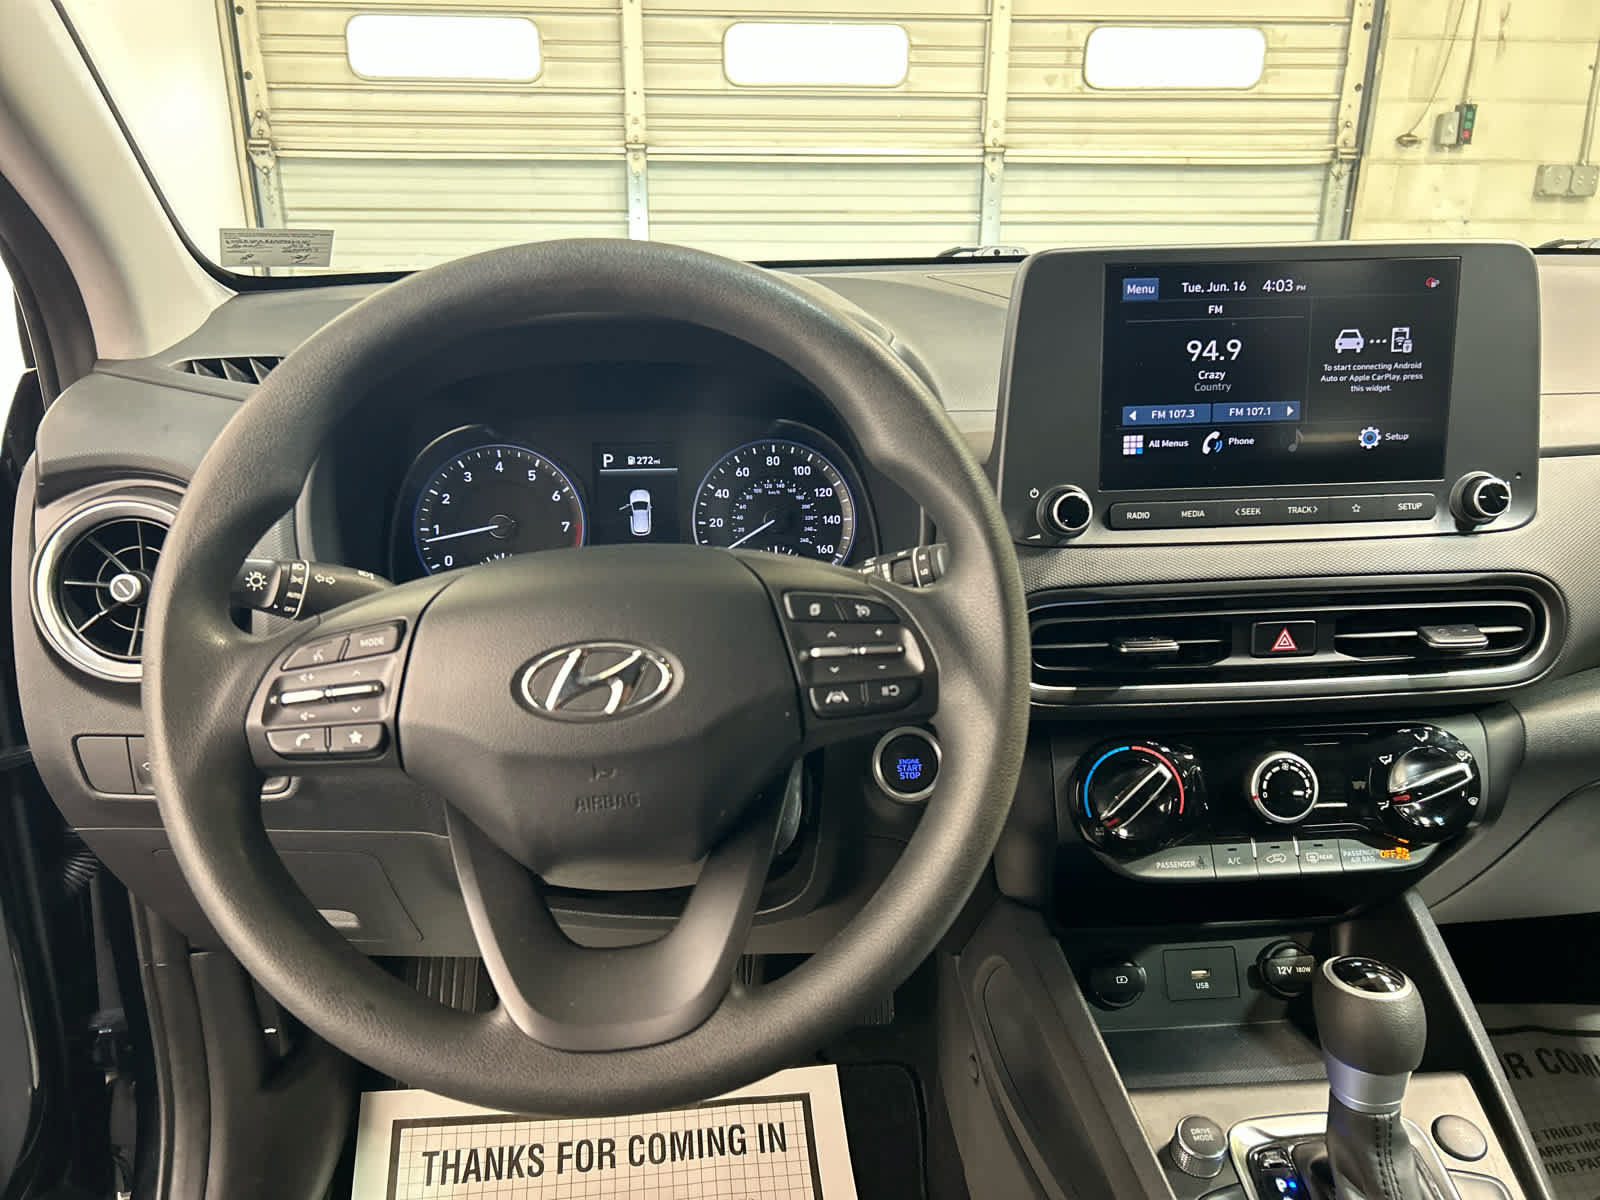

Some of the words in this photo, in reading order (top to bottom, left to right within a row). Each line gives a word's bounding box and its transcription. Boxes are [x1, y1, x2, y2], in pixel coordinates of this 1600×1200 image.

[1126, 284, 1156, 295] Menu
[1206, 281, 1230, 293] Jun.
[1233, 281, 1247, 291] 16
[1262, 279, 1294, 292] 4:03
[1208, 305, 1223, 314] FM
[1186, 339, 1242, 361] 94.9
[1352, 362, 1392, 371] connecting
[1198, 370, 1226, 380] Crazy
[1349, 374, 1370, 382] Apple
[1194, 382, 1232, 393] Country
[1152, 410, 1165, 419] FM
[1168, 409, 1195, 418] 107.3
[1229, 407, 1243, 416] FM
[1246, 407, 1271, 416] 107.1
[1228, 437, 1255, 446] Phone
[1385, 432, 1409, 442] Setup
[1149, 440, 1160, 448] All
[1162, 439, 1189, 448] Menus
[603, 453, 614, 468] P
[766, 456, 780, 466] 80
[495, 461, 504, 472] 4
[793, 466, 811, 476] 100
[463, 472, 472, 482] 3
[527, 470, 536, 481] 5
[735, 467, 750, 477] 60
[551, 491, 561, 501] 6
[714, 489, 729, 499] 40
[814, 488, 833, 497] 120
[442, 494, 450, 504] 2
[1397, 502, 1423, 511] SETUP
[1126, 511, 1151, 520] RADIO
[1181, 509, 1205, 518] MEDIA
[709, 518, 724, 528] 20
[822, 515, 841, 525] 140
[433, 525, 439, 535] 1
[561, 521, 570, 532] 7
[816, 545, 834, 554] 160
[444, 556, 453, 566] 0
[360, 636, 385, 648] MODE
[896, 764, 922, 772] START
[899, 771, 921, 780] STOP
[1379, 850, 1397, 859] OFF
[1156, 860, 1196, 869] PASSENGER
[1227, 857, 1241, 865] A/C
[1276, 966, 1292, 975] 12V
[1540, 1125, 1583, 1142] TRIED
[423, 1142, 545, 1186] THANKS
[557, 1138, 616, 1174] FOR
[628, 1124, 746, 1167] COMING
[757, 1122, 787, 1153] IN
